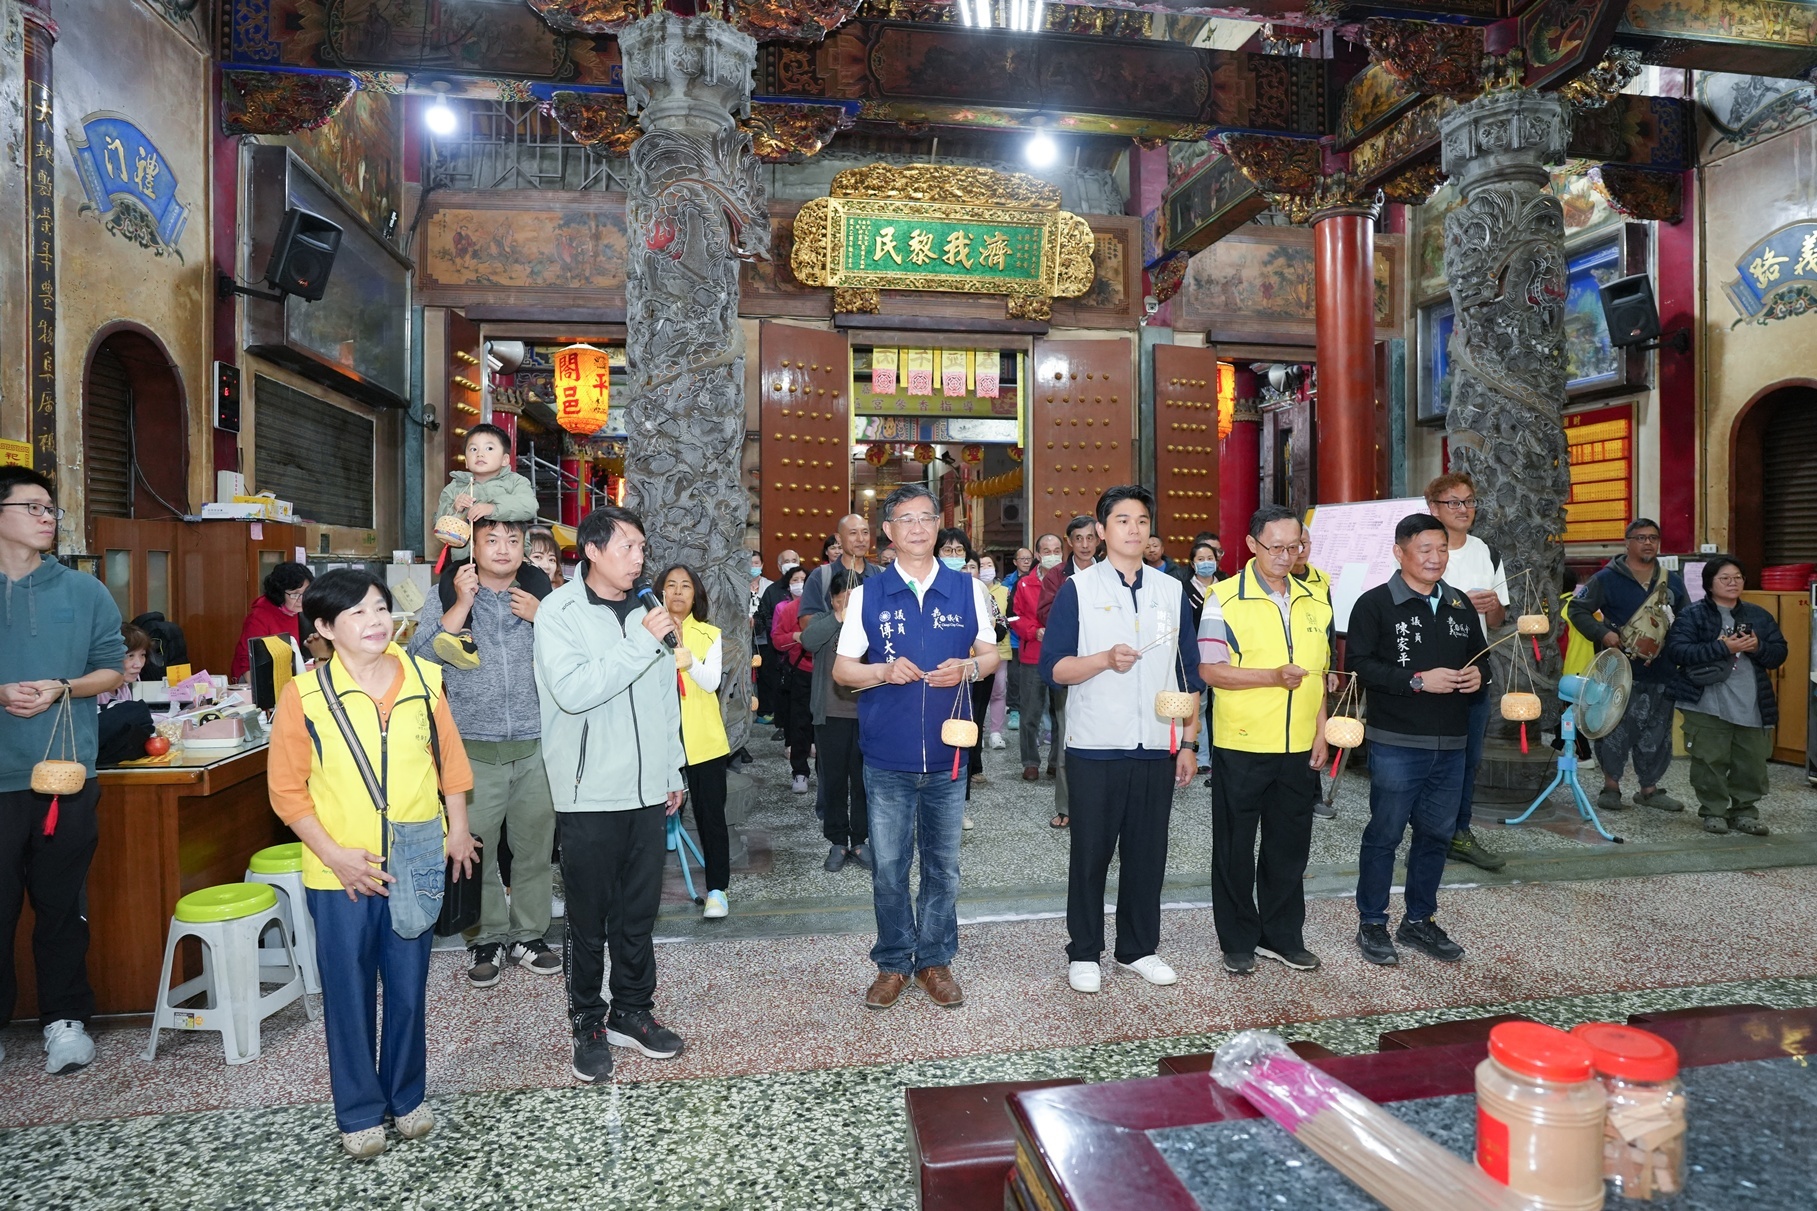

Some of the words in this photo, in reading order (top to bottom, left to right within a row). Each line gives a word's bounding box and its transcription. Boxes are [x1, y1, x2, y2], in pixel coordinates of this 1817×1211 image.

[872, 226, 1013, 272] 濟我黎民
[559, 352, 582, 416] 閤邑
[893, 609, 906, 635] 議員
[1395, 622, 1411, 667] 陳家平
[1410, 616, 1423, 644] 議員
